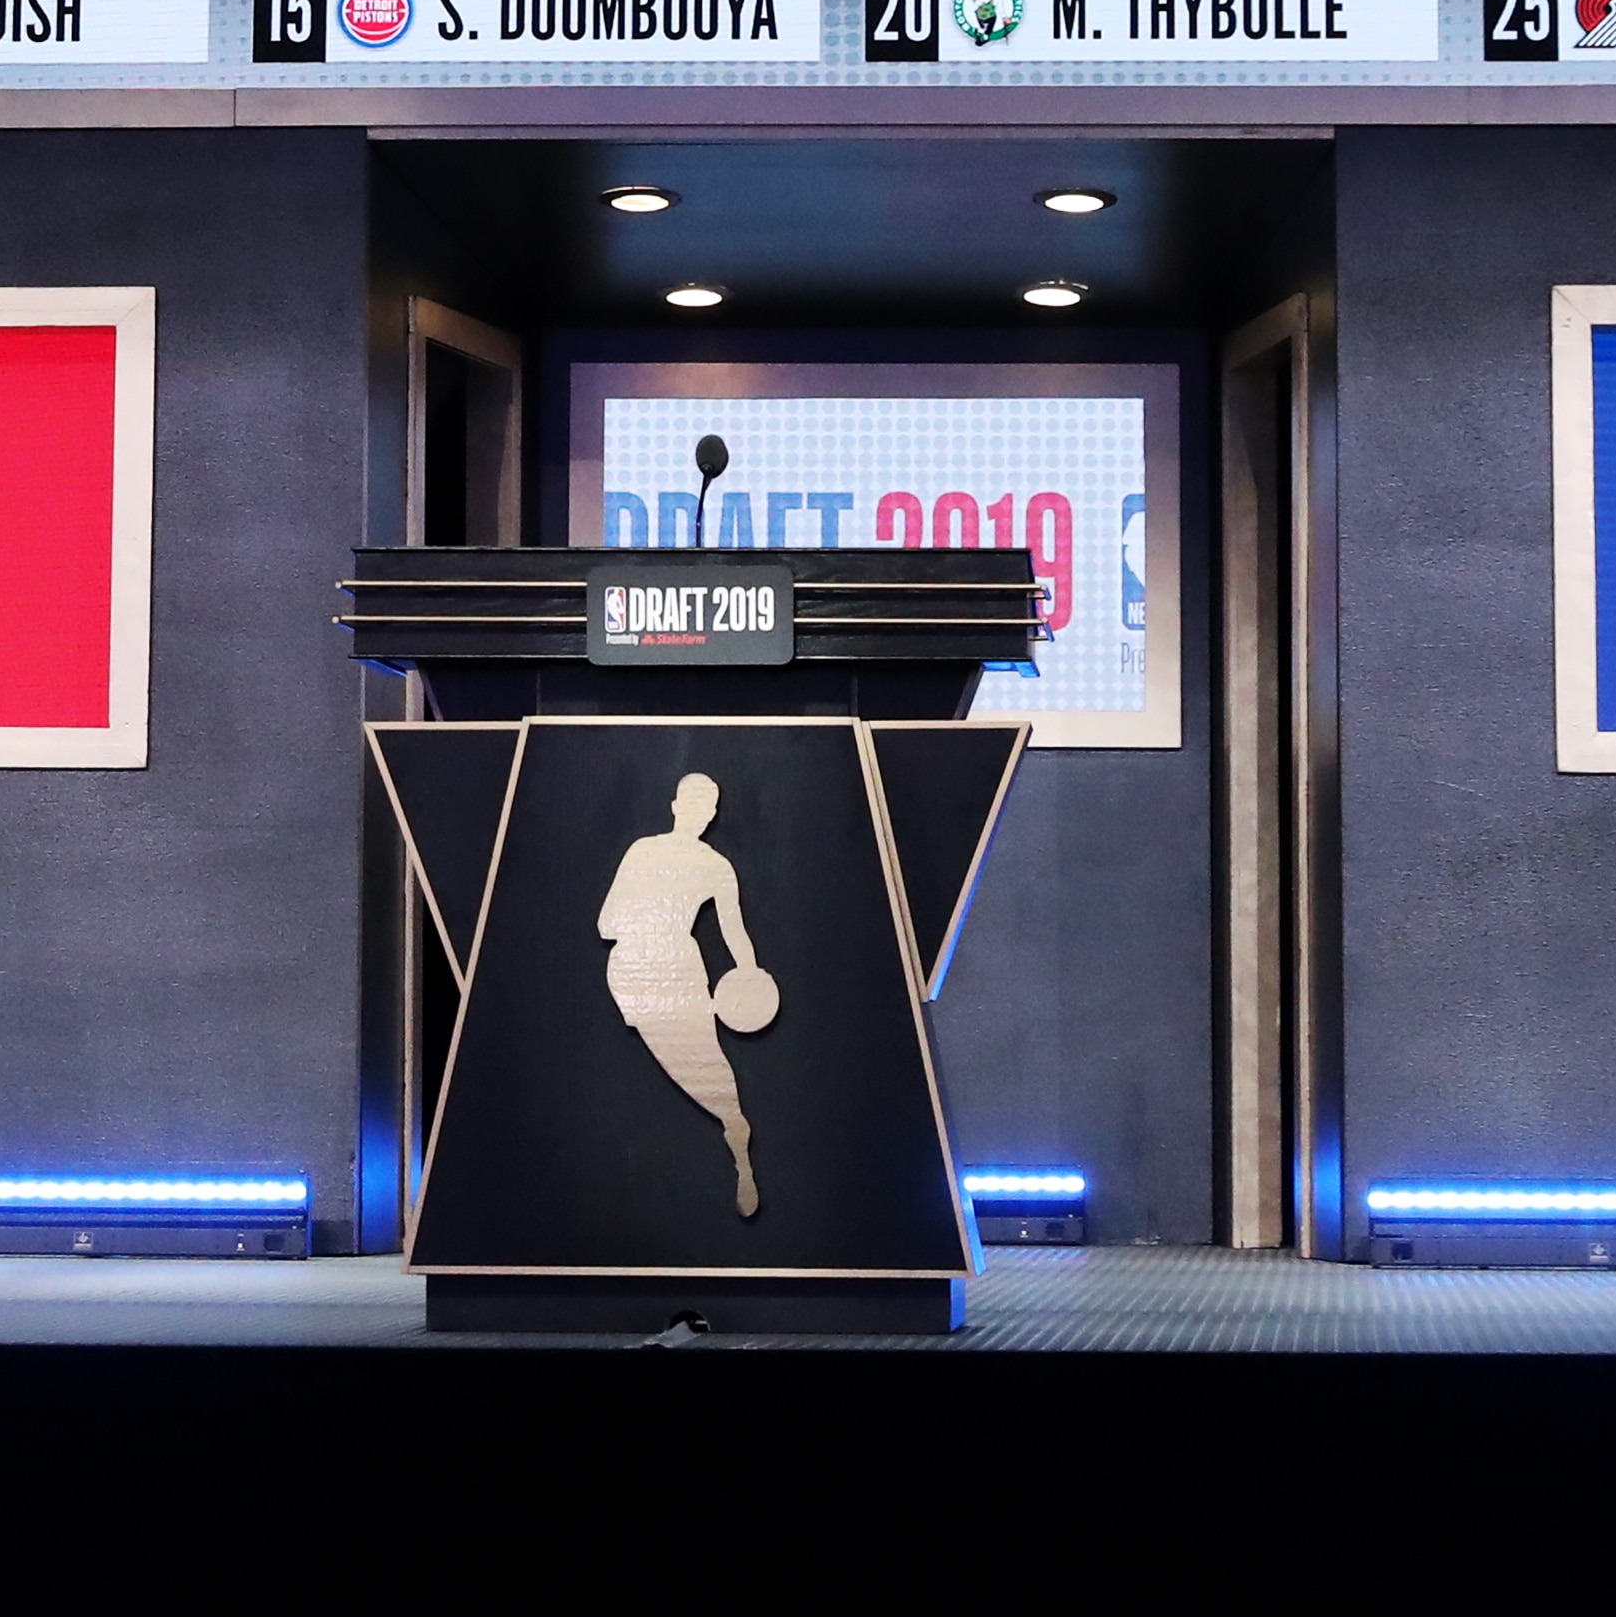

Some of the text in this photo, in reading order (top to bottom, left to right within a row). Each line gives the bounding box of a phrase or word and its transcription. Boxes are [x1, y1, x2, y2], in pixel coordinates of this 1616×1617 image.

[354, 0, 397, 11] DETROIT
[354, 11, 398, 23] PISTONS
[629, 586, 775, 632] DRAFT 2019
